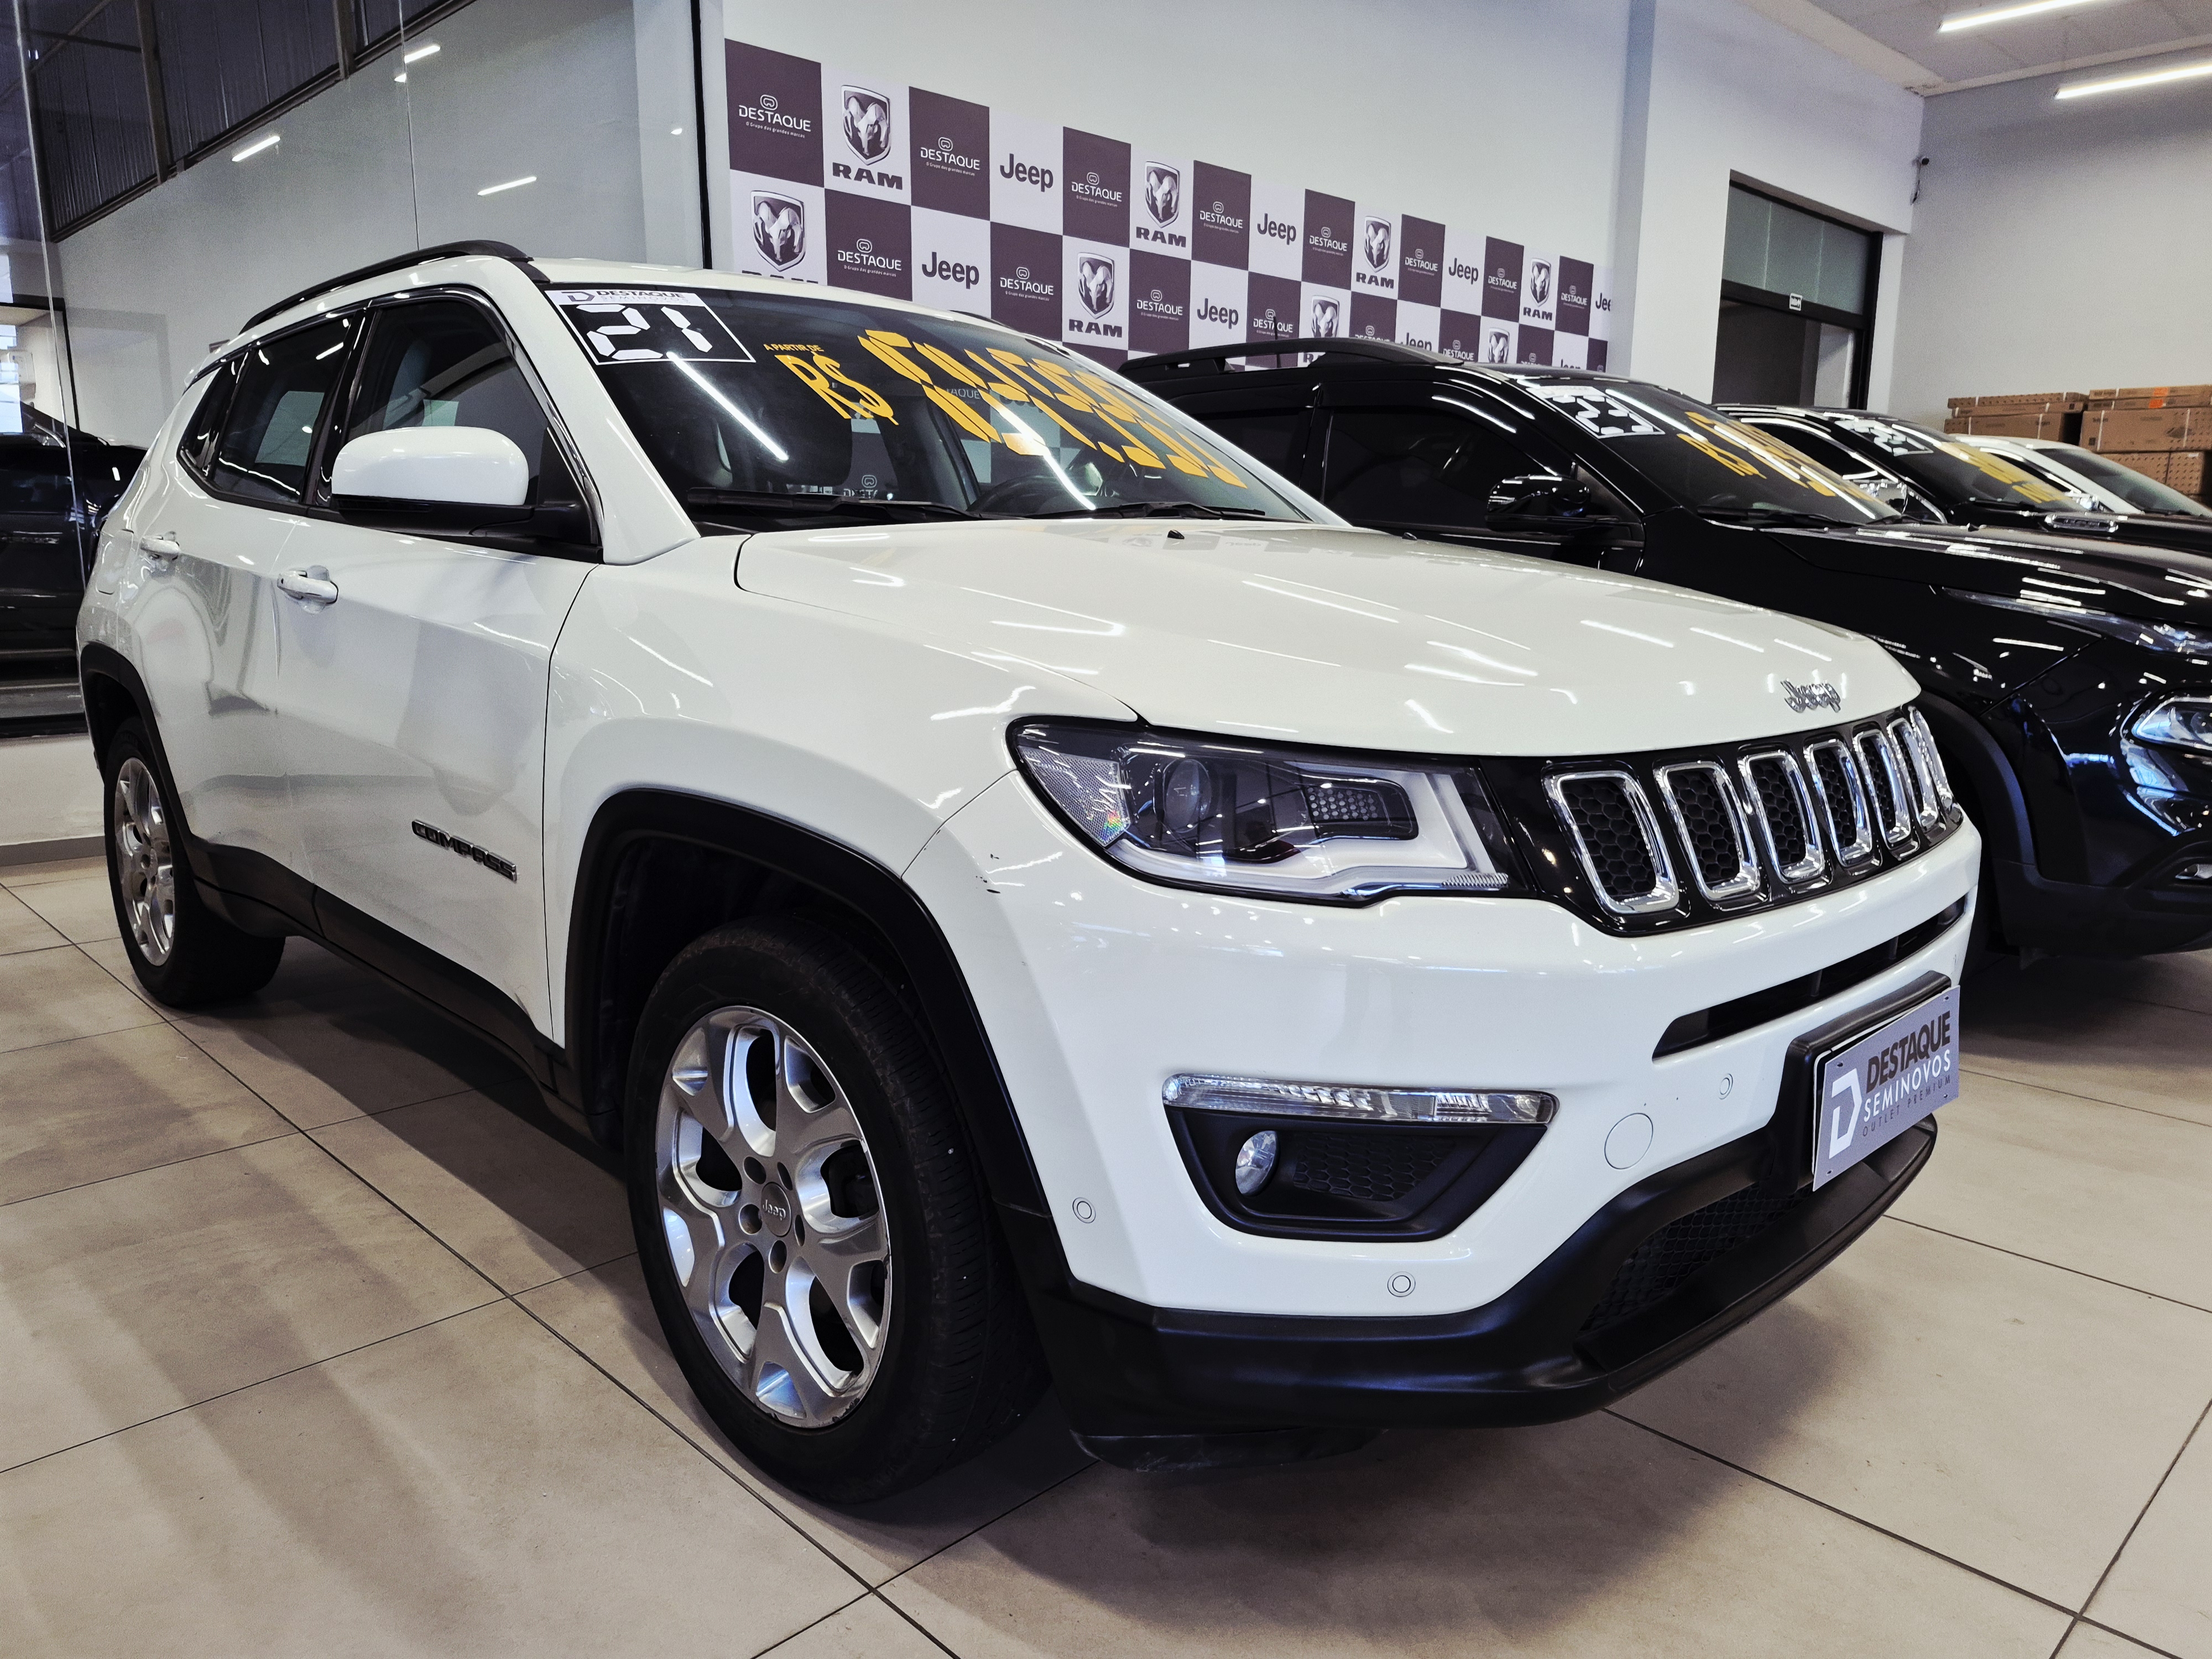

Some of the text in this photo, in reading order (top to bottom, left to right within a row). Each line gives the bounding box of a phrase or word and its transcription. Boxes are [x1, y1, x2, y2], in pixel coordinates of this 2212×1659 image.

[738, 105, 811, 132] DESTAQUE
[920, 147, 980, 170] DESTAQUE
[832, 162, 902, 190] RAM
[1000, 153, 1053, 192] Jeep
[1072, 181, 1123, 202] DESTAQUE
[1199, 210, 1243, 229] DESTAQUE
[1257, 213, 1296, 245] Jeep
[1136, 227, 1187, 248] RAM
[1309, 235, 1348, 252] DESTAQUE
[837, 250, 902, 271] DESTAQUE
[921, 252, 979, 289] Jeep
[1405, 257, 1438, 272] DESTAQUE
[1449, 258, 1479, 285] Jeep
[1000, 277, 1054, 295] DESTAQUE
[1356, 272, 1394, 289] RAM
[1488, 275, 1517, 289] DESTAQUE
[596, 290, 685, 299] DESTAQUE
[1561, 293, 1588, 306] DESTAQUE
[1136, 299, 1183, 316] DESTAQUE
[1197, 298, 1239, 329] Jeep
[1523, 306, 1553, 321] RAM
[576, 304, 712, 361] 21
[1069, 319, 1123, 338] RAM
[1443, 348, 1474, 361] DESTAQUE
[774, 351, 899, 425] R$
[1552, 395, 1654, 435] 23
[1780, 679, 1841, 713] Jeep
[411, 820, 518, 884] COMPASS
[1866, 1010, 1951, 1094] DESTAQUE
[1864, 1048, 1951, 1123] SEMINOVOS
[1863, 1074, 1951, 1137] OUTLET PREMIUM
[763, 1199, 786, 1221] Jeep
